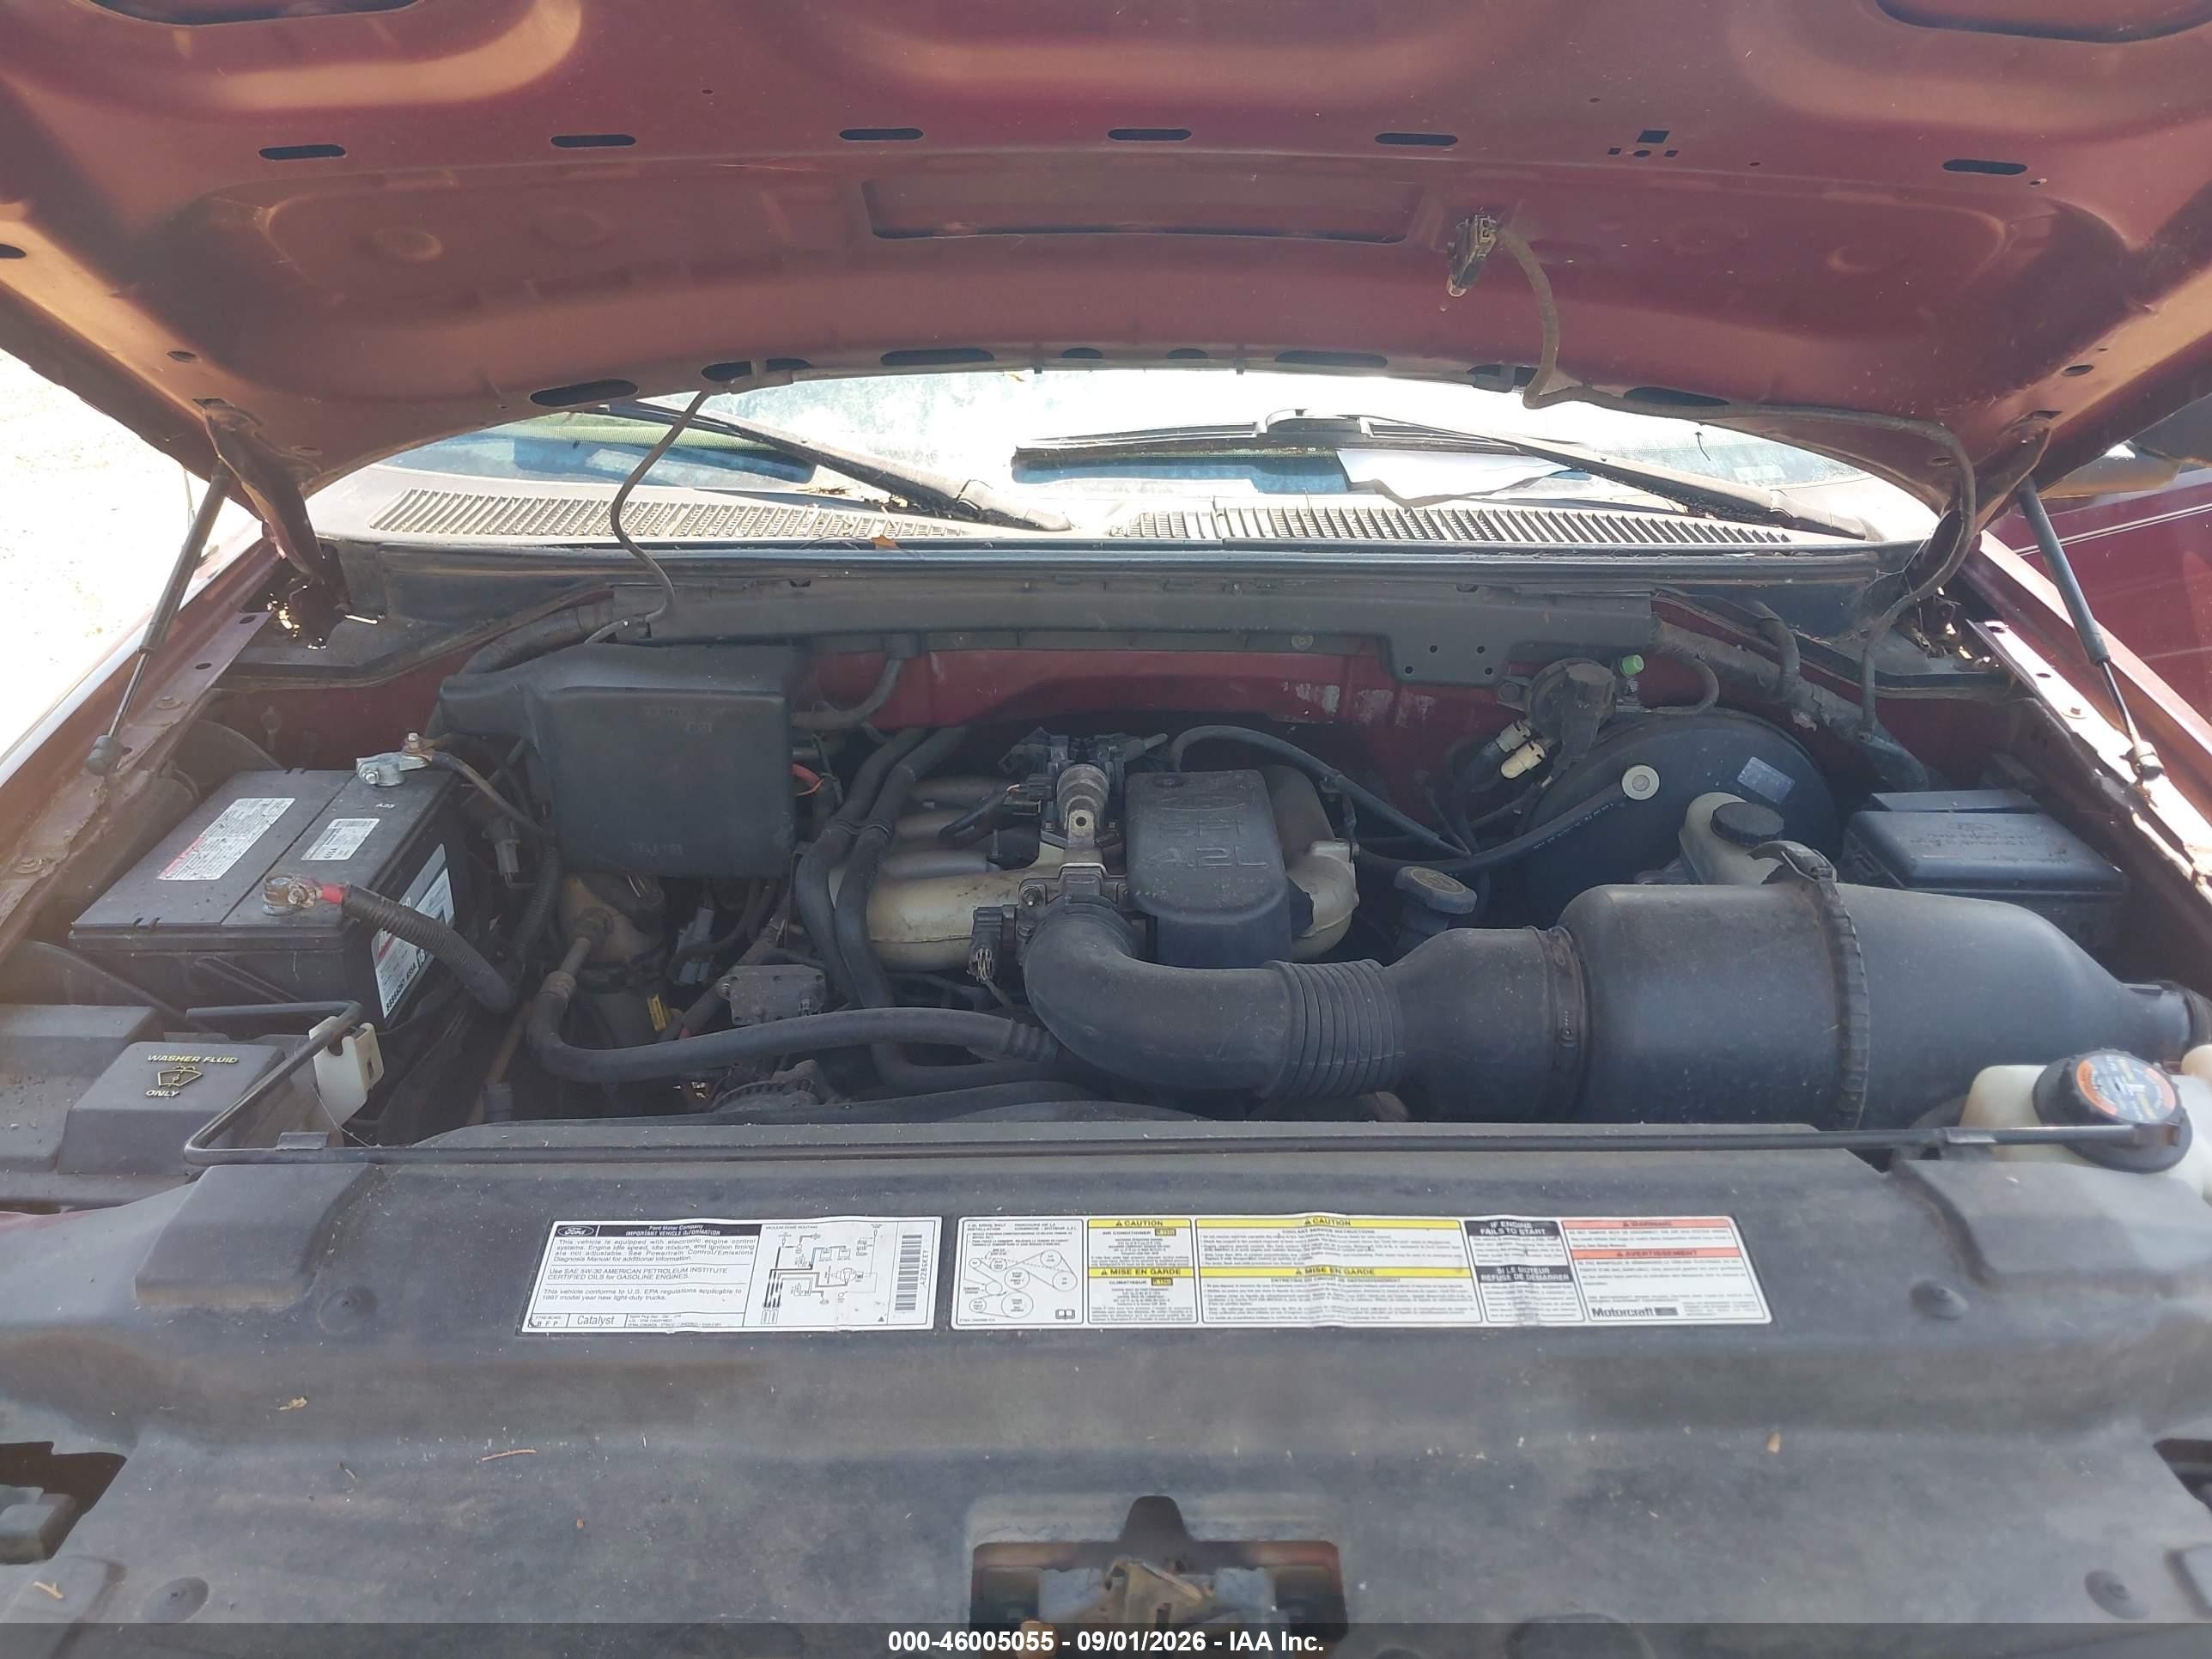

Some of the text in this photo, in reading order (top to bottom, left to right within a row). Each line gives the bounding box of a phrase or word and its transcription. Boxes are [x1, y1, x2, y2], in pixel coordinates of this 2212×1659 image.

[1146, 845, 1267, 868] 4.2L
[148, 1054, 201, 1063] WASHER
[145, 1089, 181, 1097] ONLY
[1313, 1217, 1352, 1226] CAUTION
[1500, 1220, 1533, 1229] ENGINE
[564, 1226, 586, 1236] Ford
[1518, 1266, 1551, 1274] MOTEUR
[1591, 1306, 1655, 1317] Motorcraft
[576, 1315, 616, 1327] Catalyst
